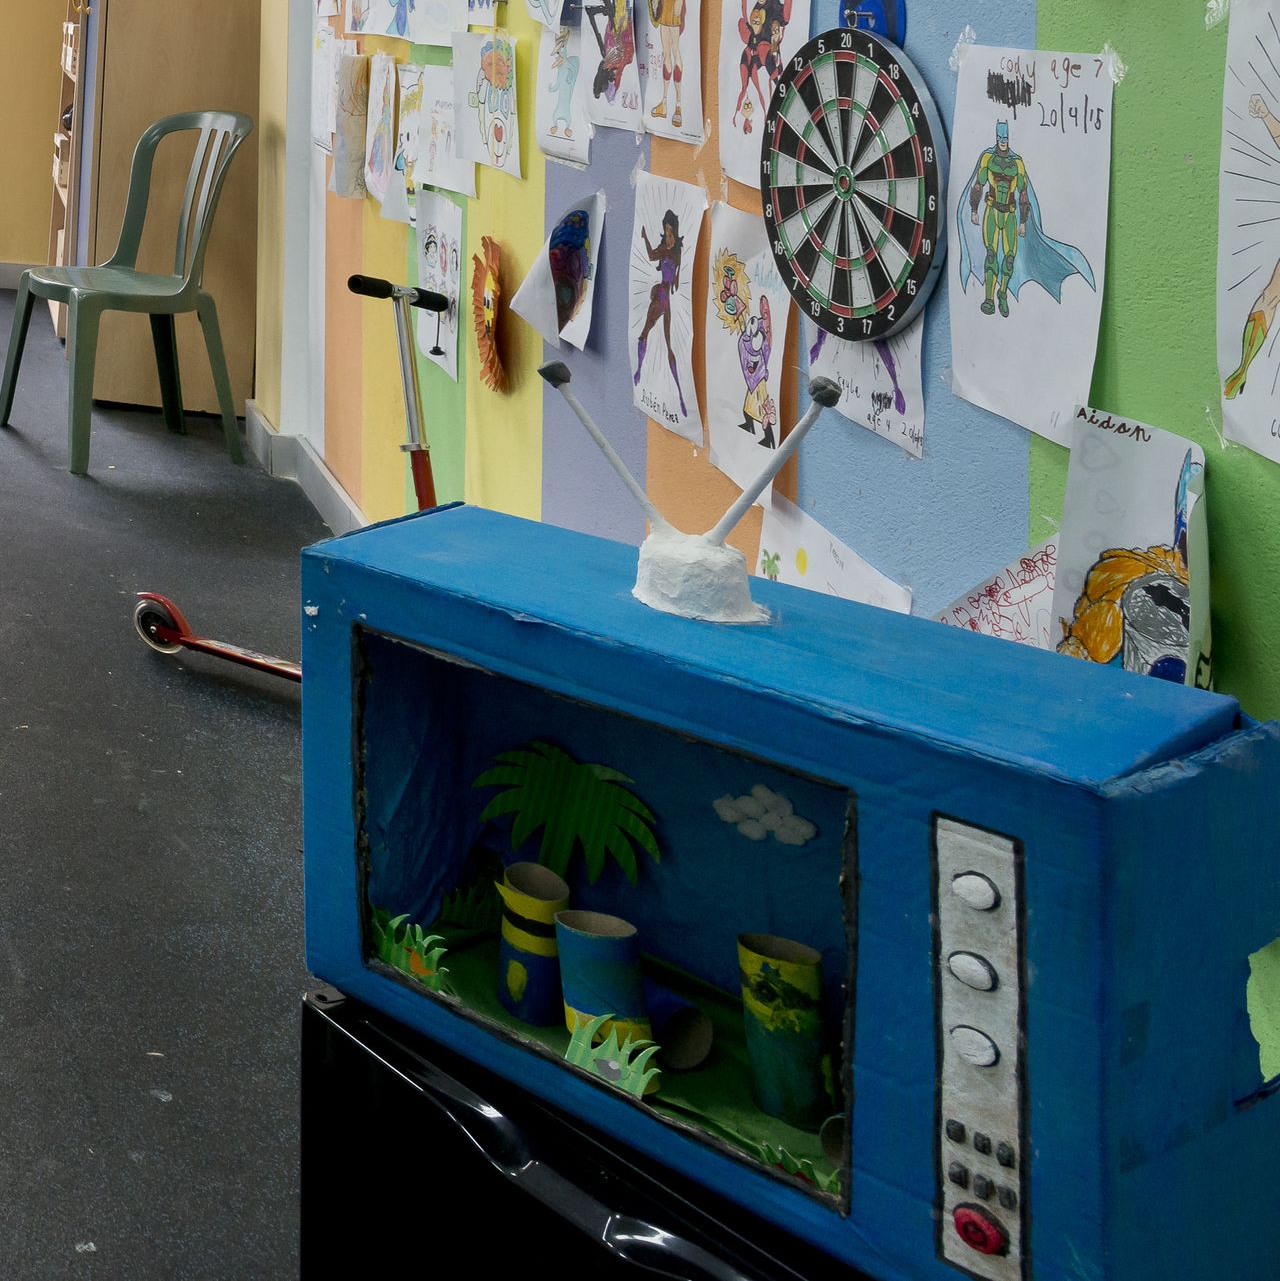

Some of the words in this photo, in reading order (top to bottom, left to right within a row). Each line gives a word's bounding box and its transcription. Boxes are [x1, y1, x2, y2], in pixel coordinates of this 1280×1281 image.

[818, 40, 825, 54] 5
[841, 33, 852, 48] 20
[868, 43, 874, 57] 1
[793, 57, 803, 72] 12
[889, 64, 900, 80] 18
[1093, 59, 1104, 78] 7
[779, 84, 786, 97] 9
[912, 102, 919, 118] 4
[767, 120, 775, 133] 14
[923, 146, 933, 163] 13
[763, 160, 770, 174] 11
[928, 195, 936, 211] 6
[766, 204, 772, 218] 8
[774, 240, 784, 255] 16
[921, 239, 931, 255] 10
[792, 276, 799, 290] 7
[906, 279, 916, 295] 15
[810, 300, 821, 317] 19
[887, 305, 895, 321] 2
[837, 318, 844, 333] 3
[862, 318, 872, 335] 17
[1077, 407, 1151, 442] Aidan
